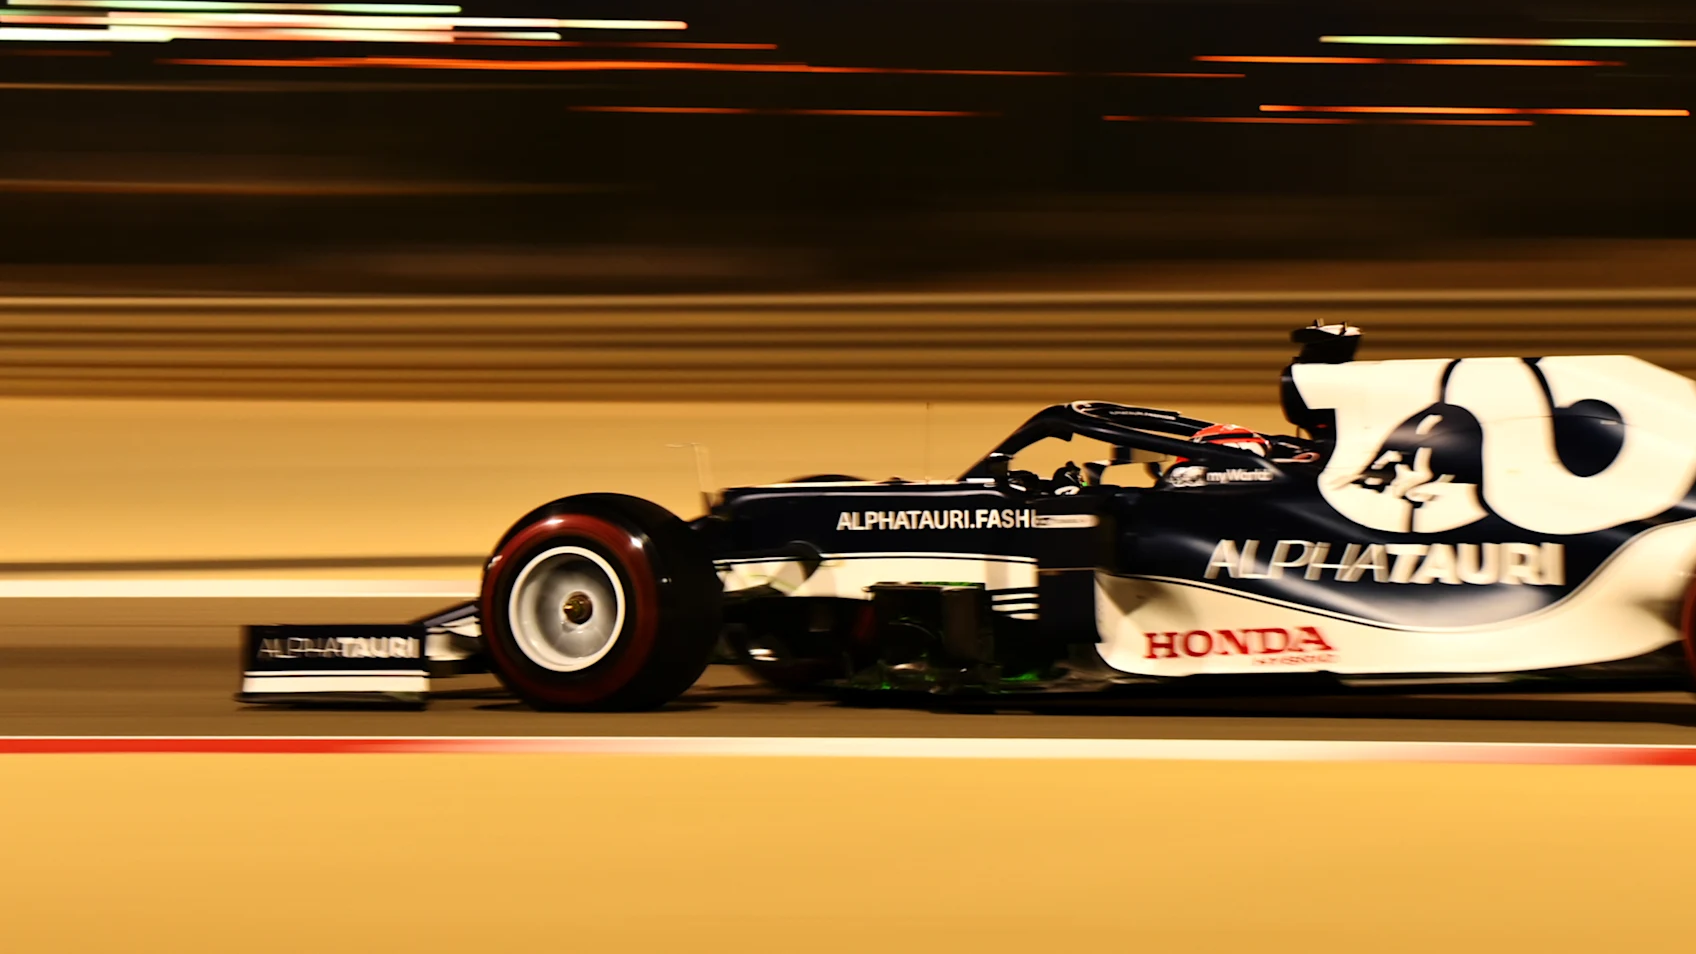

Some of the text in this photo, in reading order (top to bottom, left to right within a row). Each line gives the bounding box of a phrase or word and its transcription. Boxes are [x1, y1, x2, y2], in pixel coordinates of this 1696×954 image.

[836, 509, 1037, 530] ALPHATAURI.FASHI
[1203, 539, 1566, 586] ALPHATAURI
[1144, 626, 1334, 659] HONDA
